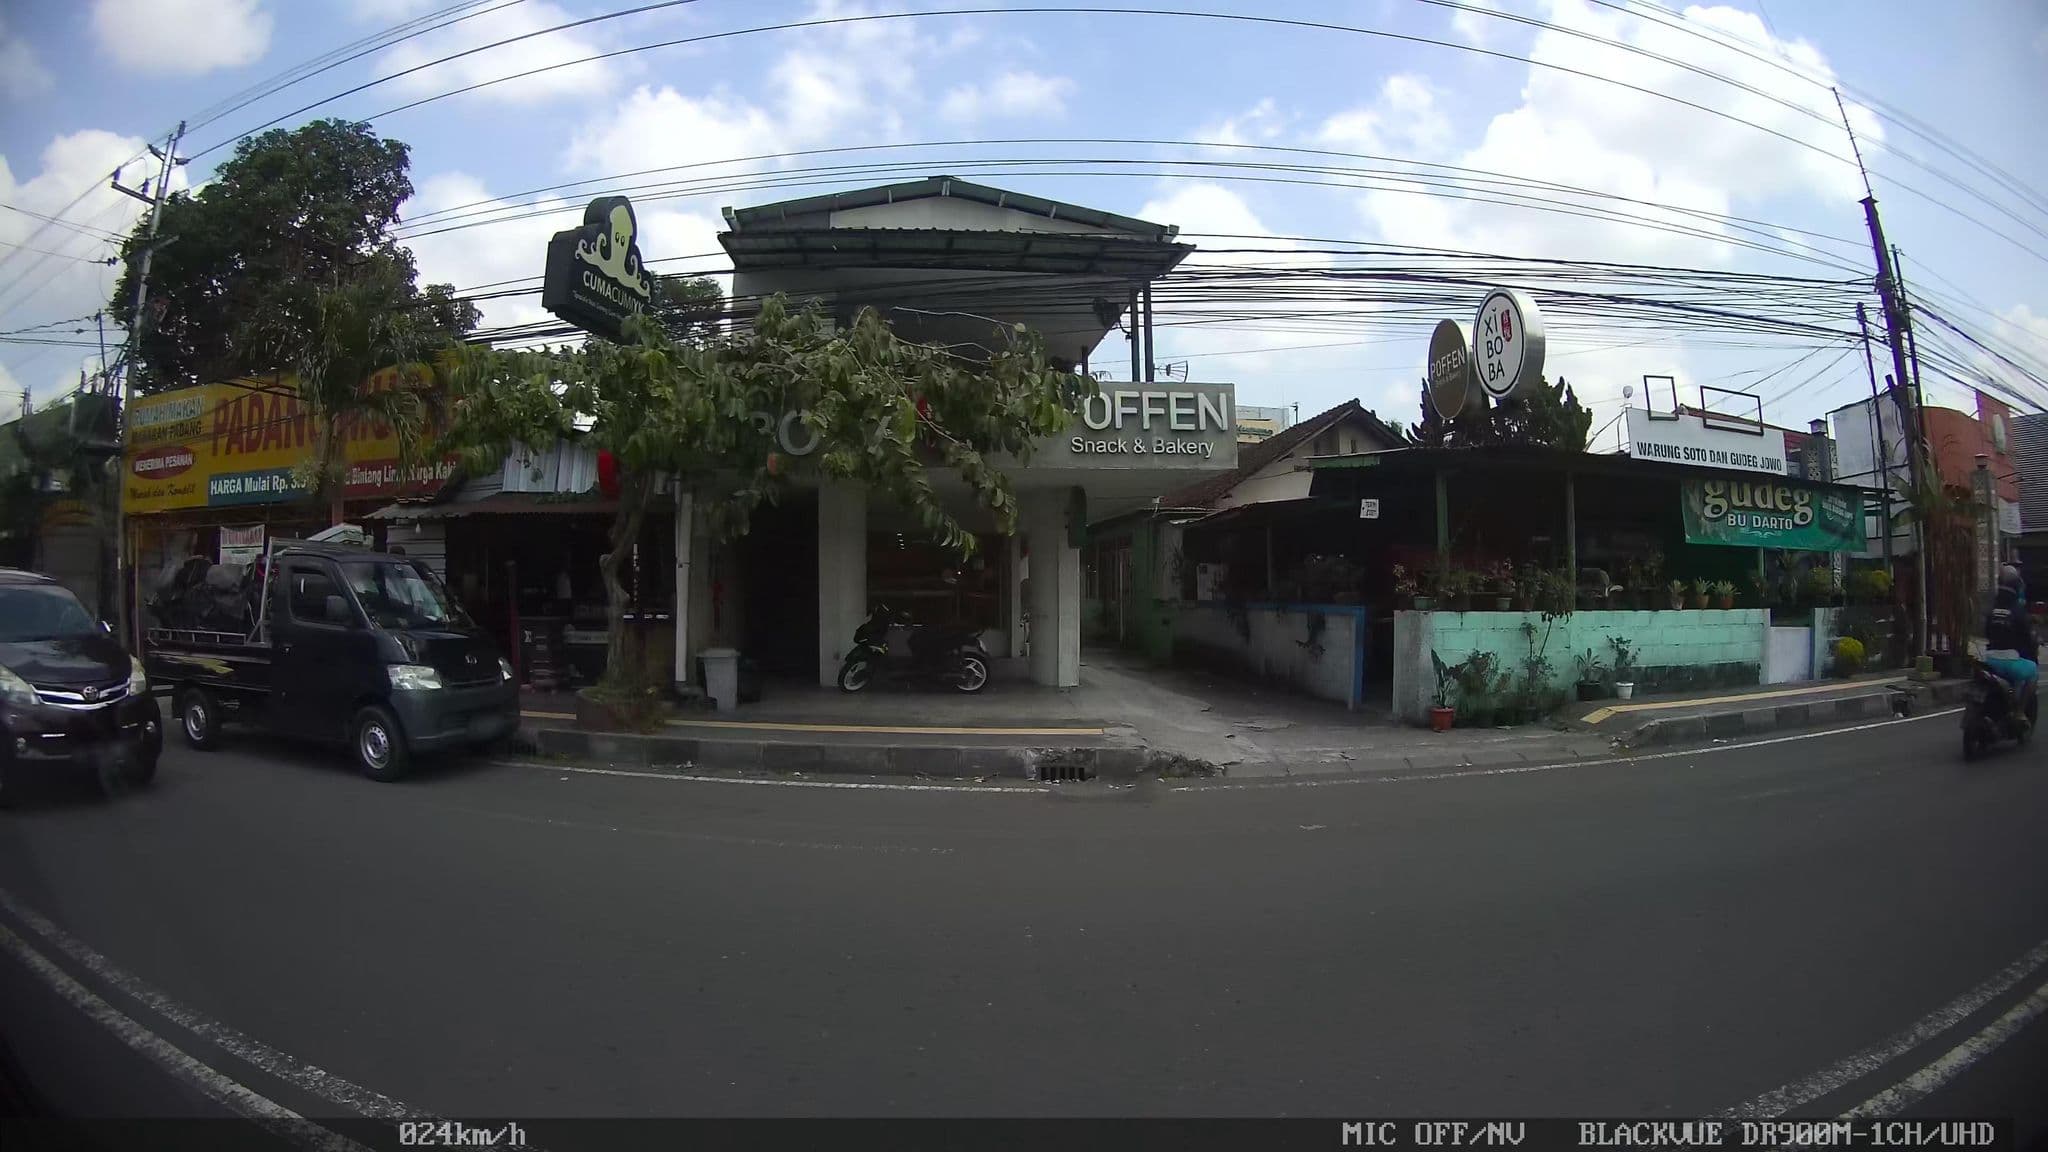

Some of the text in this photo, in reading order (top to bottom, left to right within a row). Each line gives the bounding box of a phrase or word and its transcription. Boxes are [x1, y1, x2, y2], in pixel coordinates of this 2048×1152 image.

[1486, 335, 1504, 359] BO
[1430, 346, 1466, 380] POFFEN
[1488, 359, 1505, 382] BA
[1071, 436, 1215, 459] Snack & Bakery
[1637, 441, 1782, 471] WARUNG SOTO DAN GUDEG JOWO
[210, 477, 243, 496] HARGA
[244, 475, 270, 493] Mulai
[272, 474, 289, 494] Rp.
[352, 466, 382, 487] Bintang
[1703, 480, 1814, 526] gudeg
[1727, 513, 1793, 530] BU DARTO
